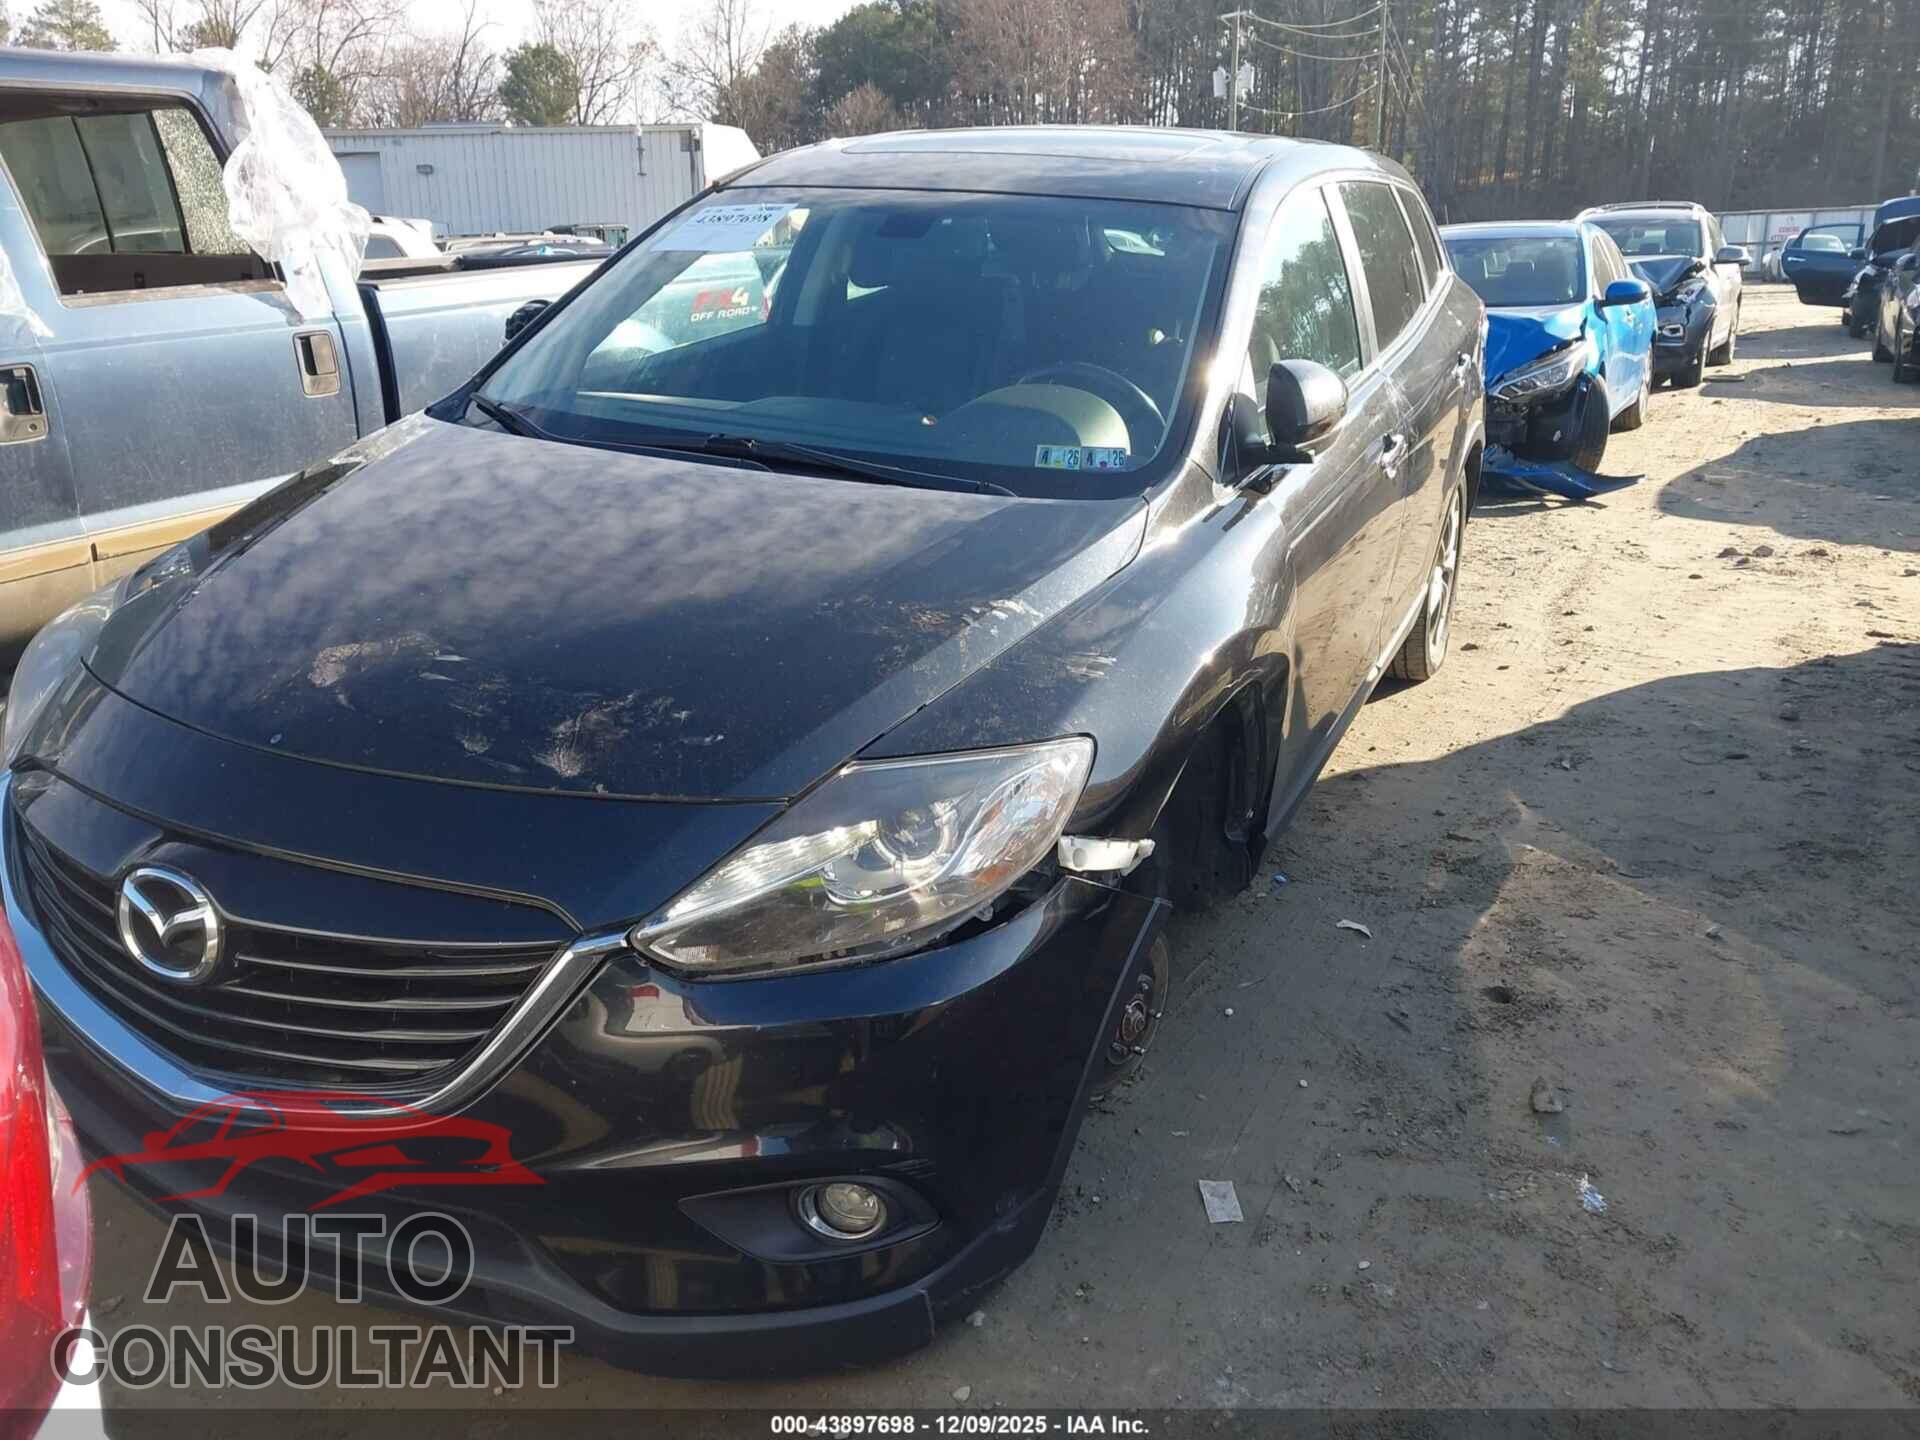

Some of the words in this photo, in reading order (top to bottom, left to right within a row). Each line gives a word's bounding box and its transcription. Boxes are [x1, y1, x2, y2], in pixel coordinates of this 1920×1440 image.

[690, 310, 714, 322] OFF
[717, 305, 752, 318] ROAD
[1067, 449, 1080, 466] 26
[1112, 450, 1125, 467] 26
